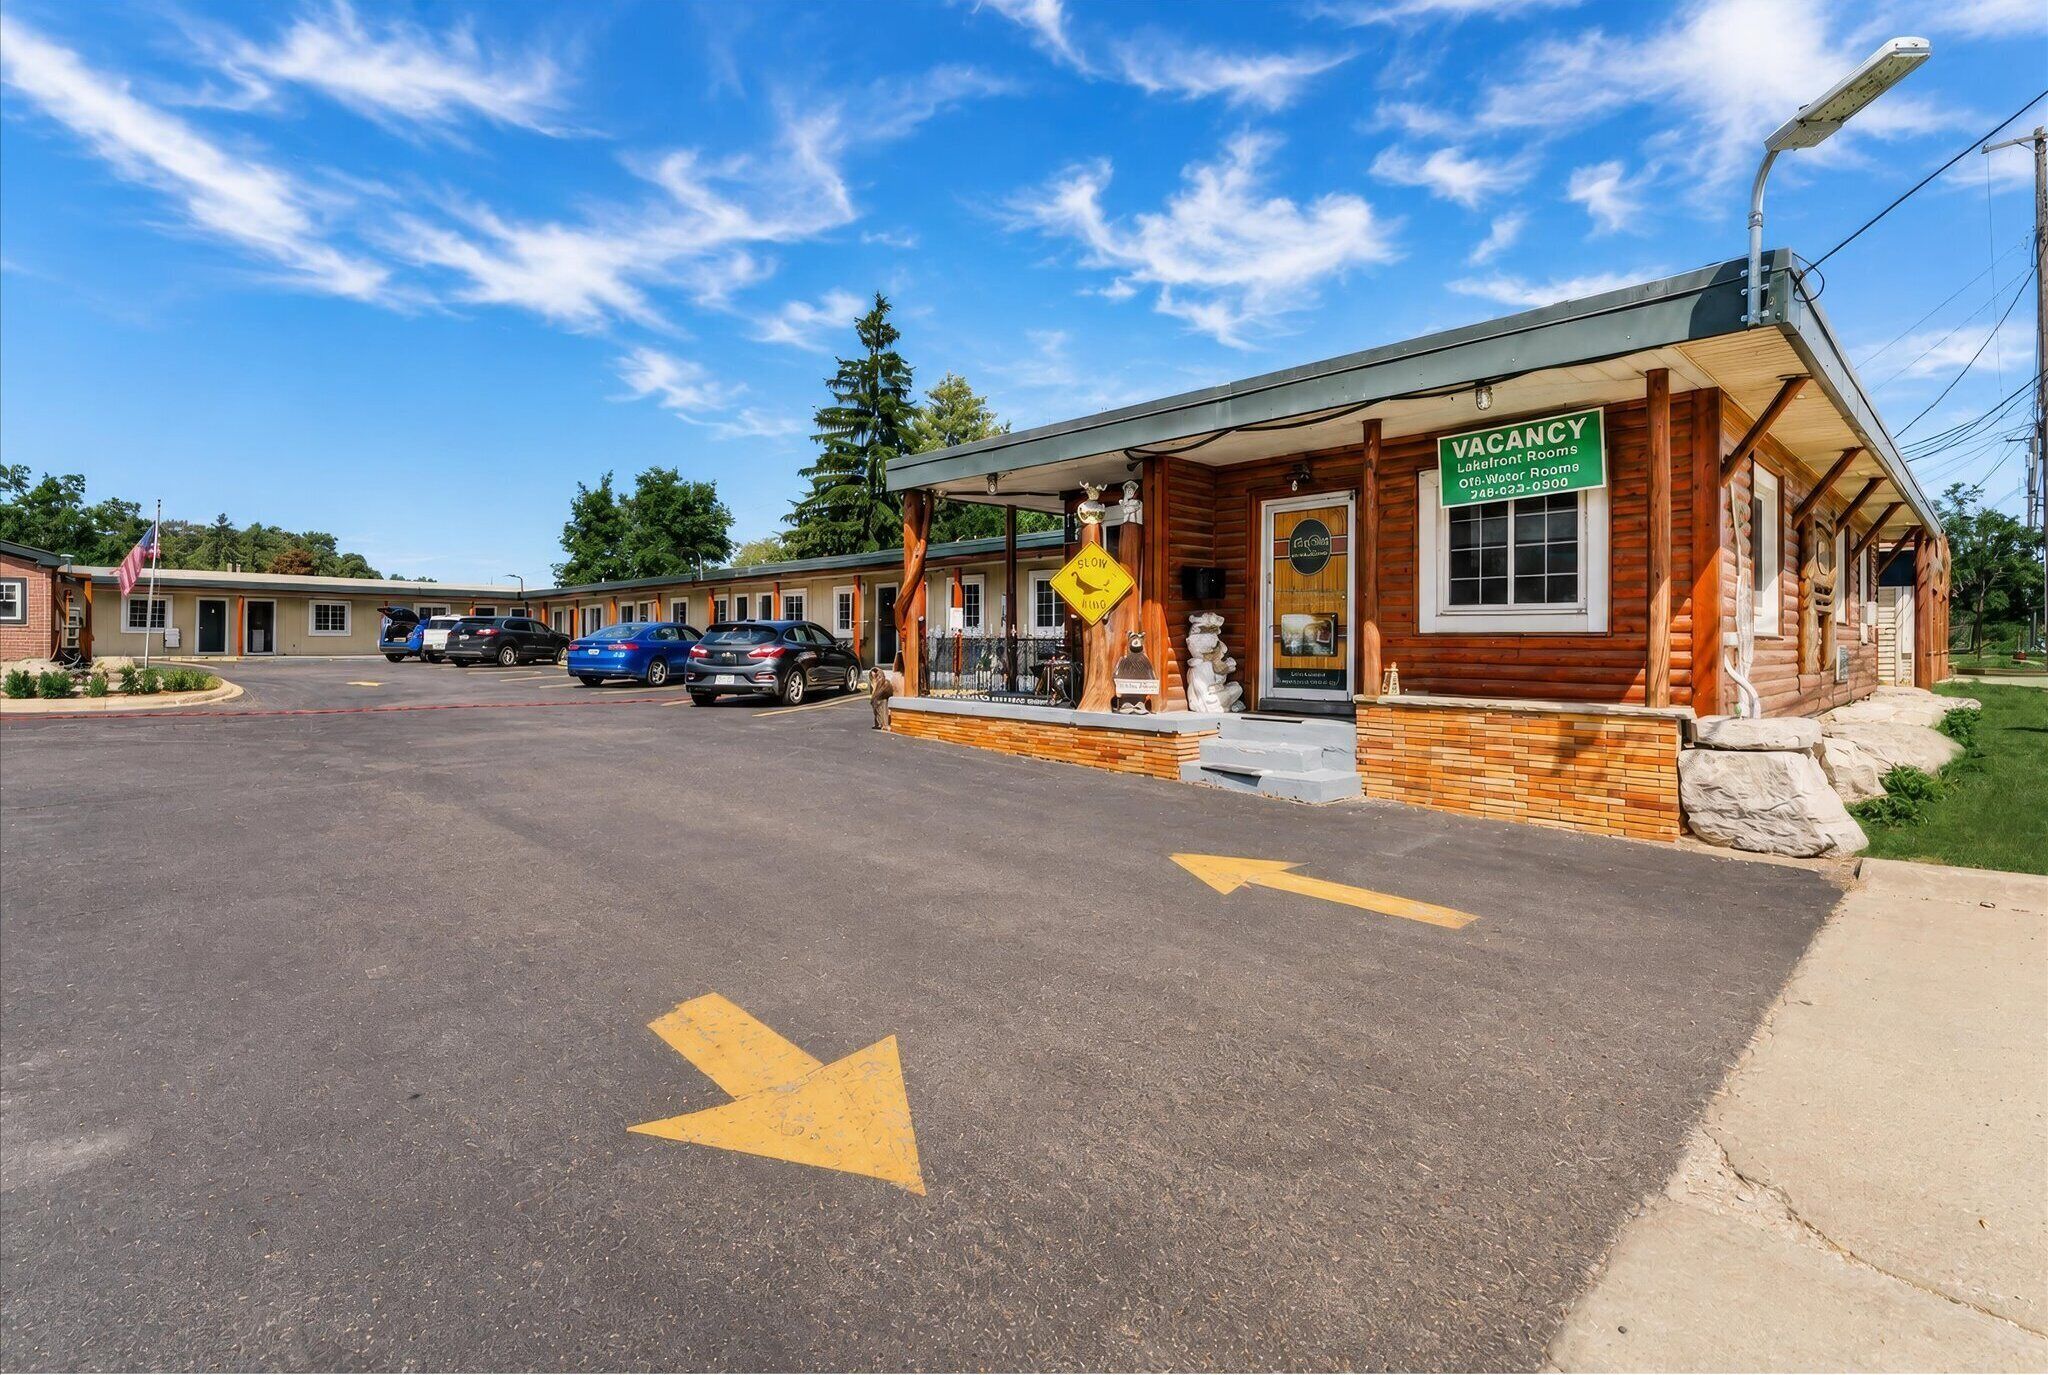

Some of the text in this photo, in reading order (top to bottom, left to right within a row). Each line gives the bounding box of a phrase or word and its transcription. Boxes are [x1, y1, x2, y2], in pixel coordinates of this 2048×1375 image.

[1452, 417, 1587, 459] VACANCY
[1457, 445, 1578, 473] Lakefront Rooms
[1077, 557, 1108, 569] SLOW
